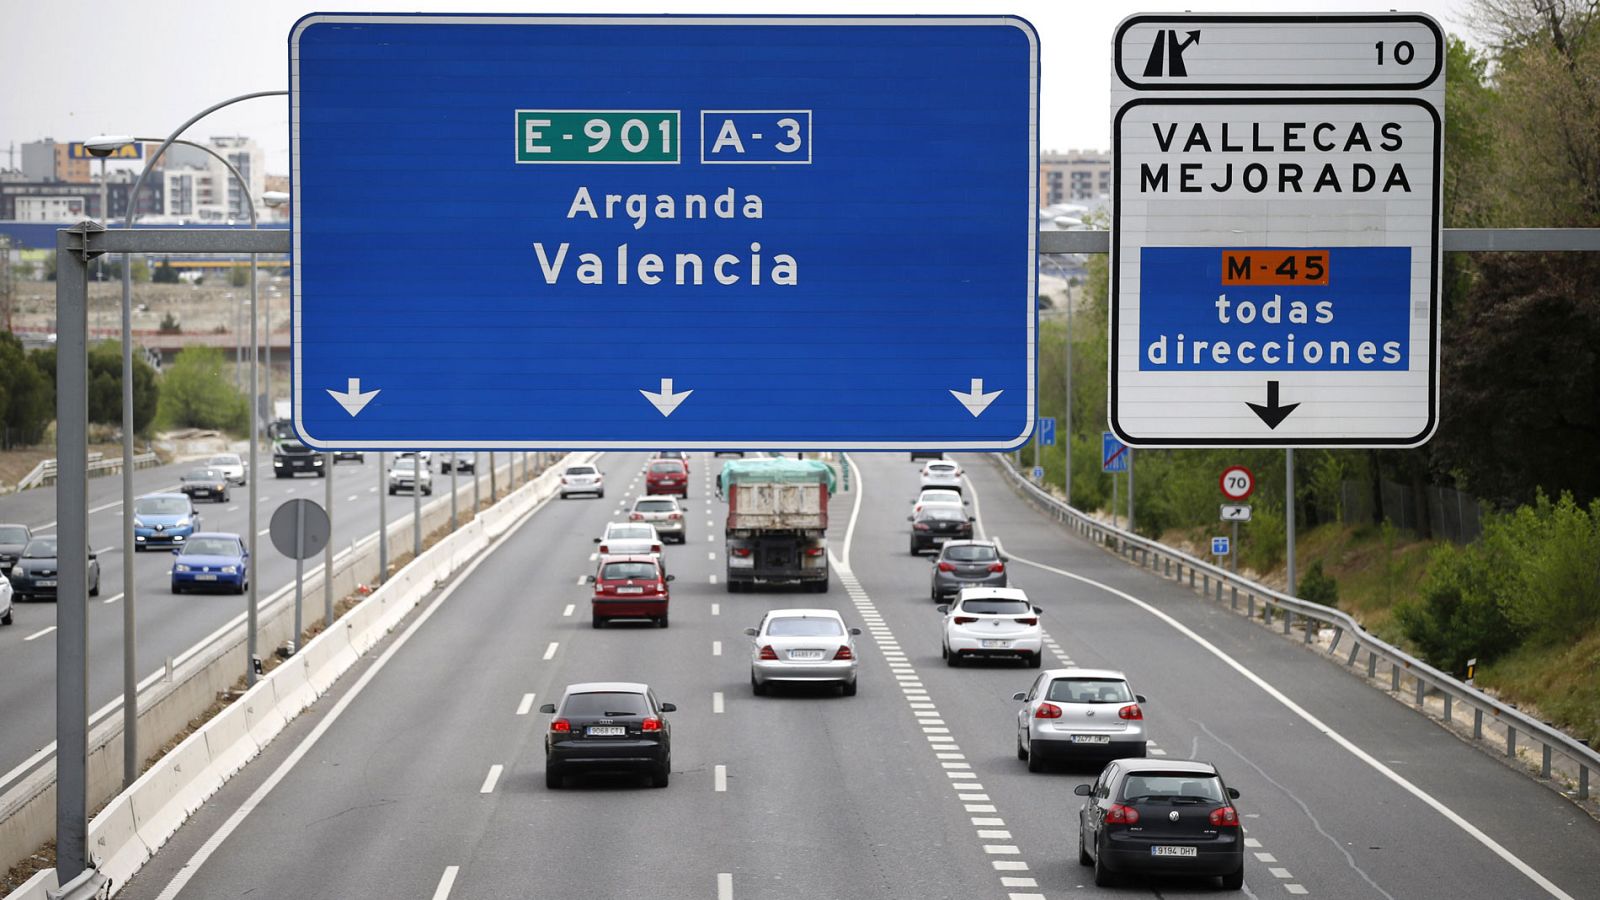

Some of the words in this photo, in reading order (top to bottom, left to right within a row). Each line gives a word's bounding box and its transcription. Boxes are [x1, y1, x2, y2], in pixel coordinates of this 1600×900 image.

[1375, 40, 1415, 66] 10
[525, 118, 671, 153] E-901
[711, 118, 802, 153] A-3
[1152, 122, 1403, 153] VALLECAS
[1140, 163, 1412, 193] MEJORADA
[566, 186, 763, 230] Arganda
[533, 242, 798, 286] Valencia
[1227, 256, 1325, 281] M-45
[1215, 294, 1334, 324] todas
[1147, 334, 1401, 365] direcciones
[1228, 477, 1247, 489] 70
[1157, 847, 1177, 855] 9194
[1180, 847, 1195, 855] DHY
